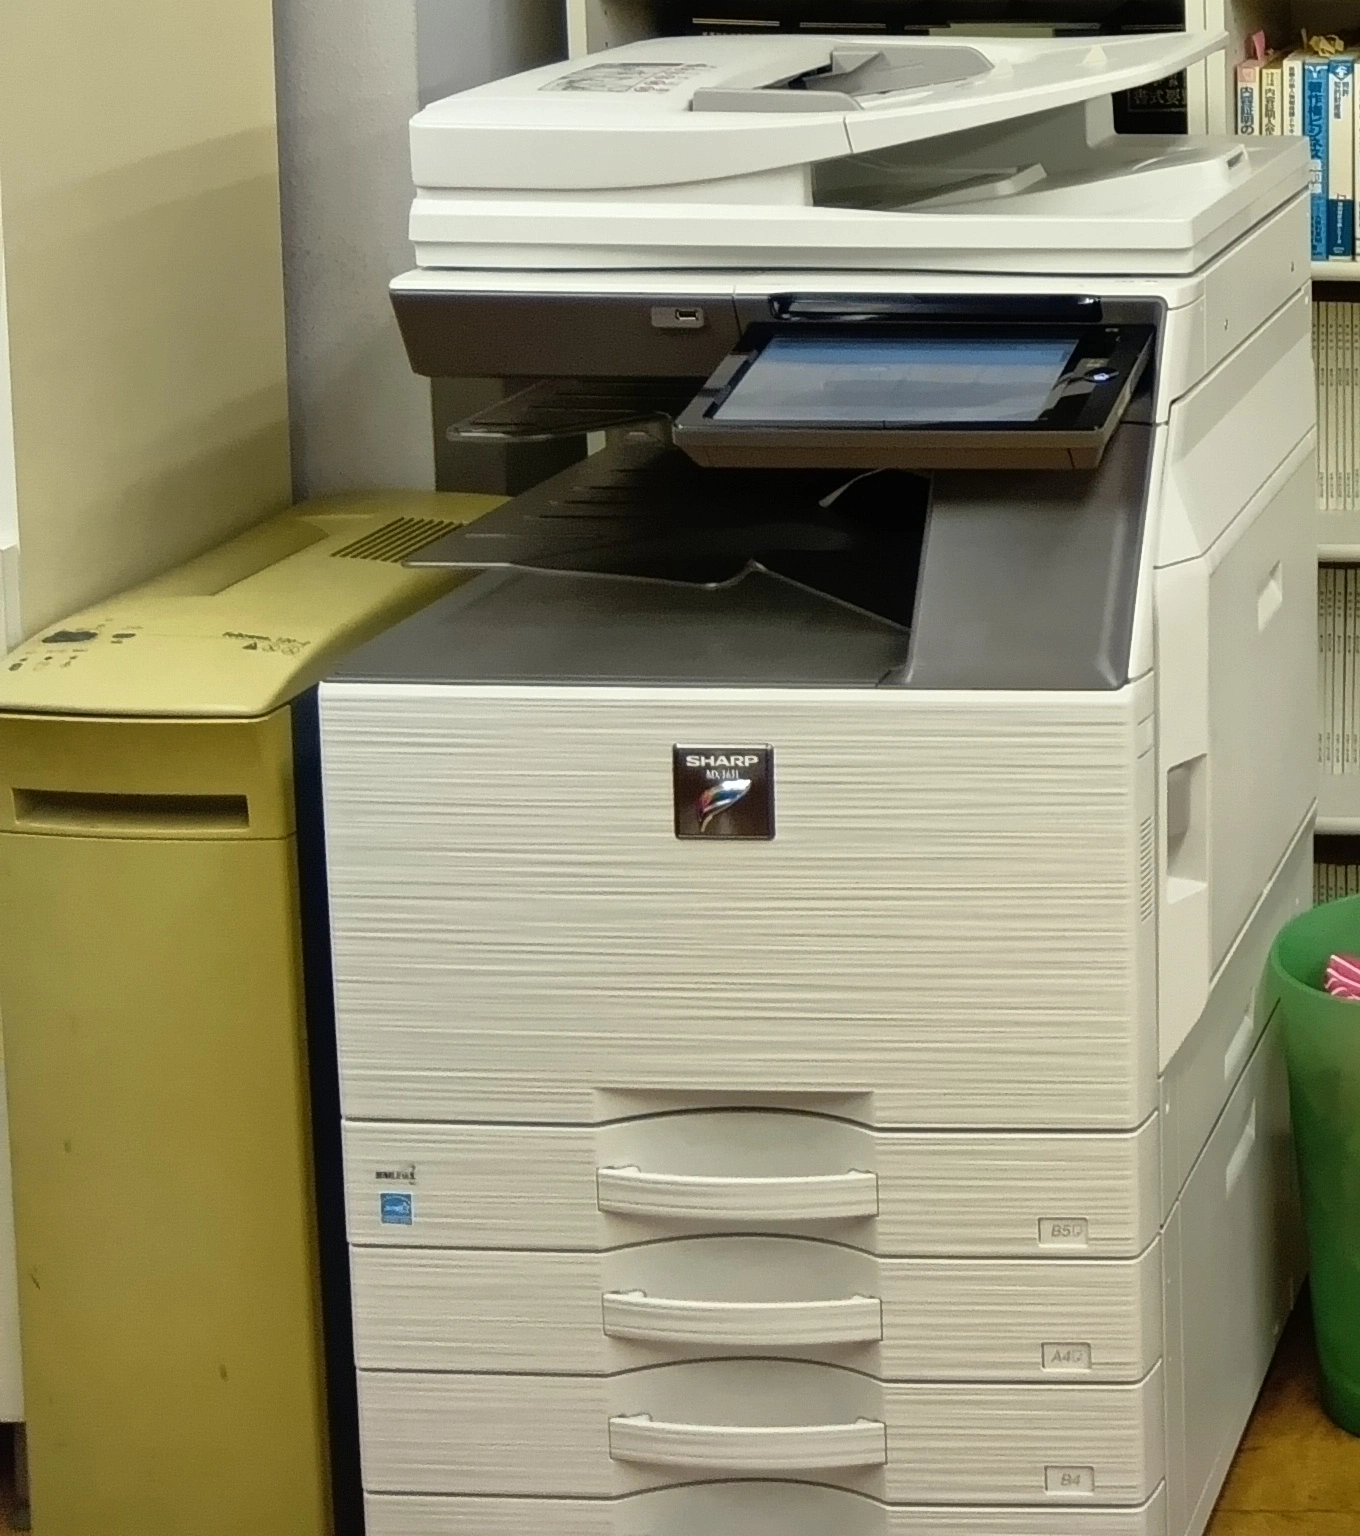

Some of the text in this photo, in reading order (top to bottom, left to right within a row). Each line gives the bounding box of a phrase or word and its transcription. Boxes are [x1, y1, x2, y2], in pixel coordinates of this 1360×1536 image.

[686, 754, 760, 768] SHARP
[1050, 1223, 1071, 1238] B5
[1051, 1349, 1071, 1362] A4
[1060, 1474, 1081, 1487] B4
